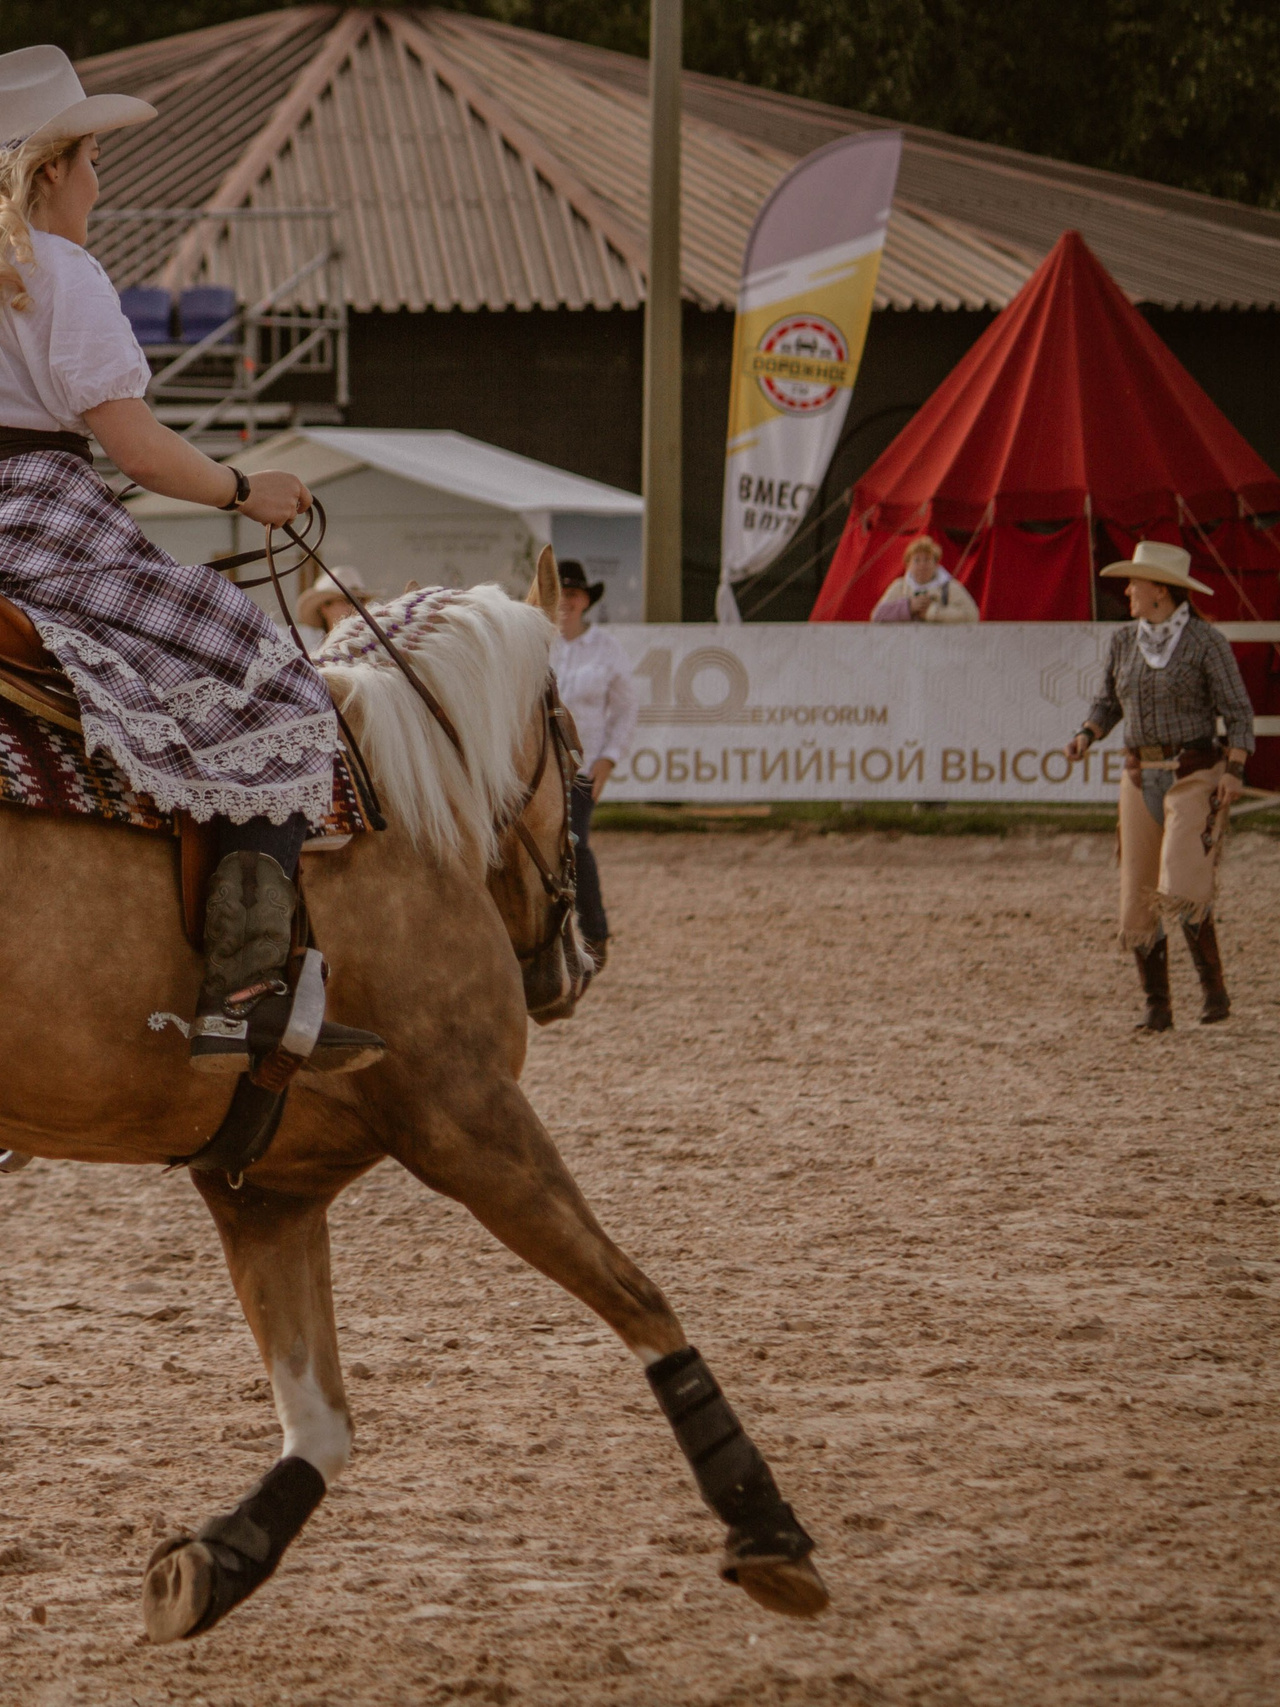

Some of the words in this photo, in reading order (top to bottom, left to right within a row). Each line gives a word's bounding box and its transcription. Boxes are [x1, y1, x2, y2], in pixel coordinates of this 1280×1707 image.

[633, 646, 749, 725] 10
[751, 705, 888, 726] EXPOFORUM
[940, 748, 1122, 784] ВЫСОТЕ
